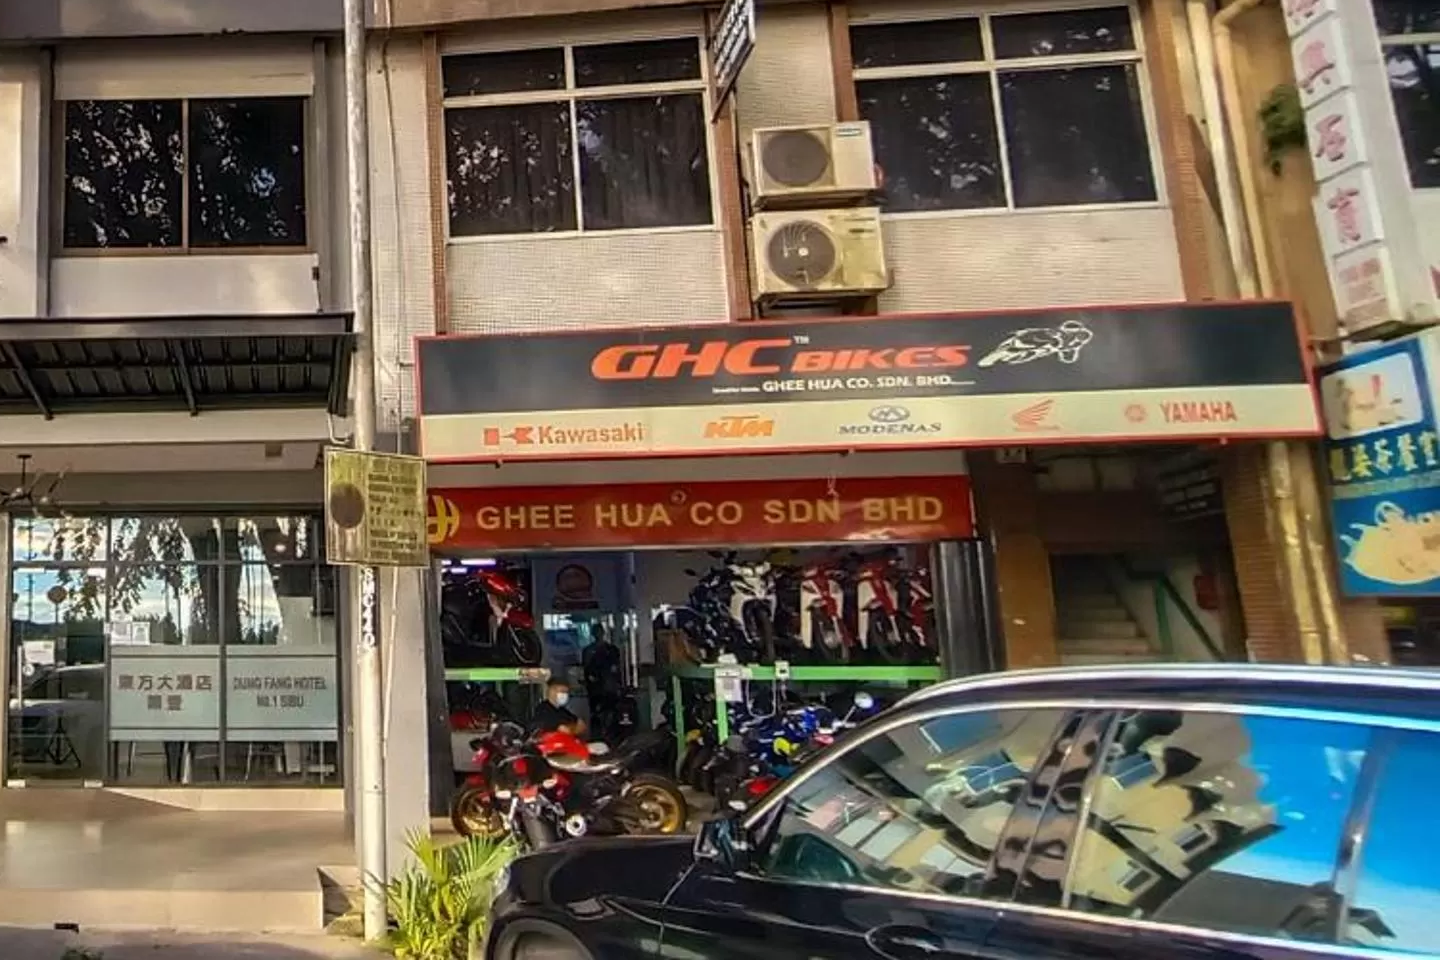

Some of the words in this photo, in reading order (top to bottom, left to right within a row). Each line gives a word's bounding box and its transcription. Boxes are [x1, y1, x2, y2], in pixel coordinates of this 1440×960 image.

[591, 338, 792, 380] GHC
[791, 345, 972, 373] BIKES
[762, 378, 806, 392] GHEE
[810, 377, 844, 390] HUA
[1160, 401, 1238, 423] YAMAHA
[538, 423, 644, 445] Kawasaki
[704, 415, 775, 439] KTM
[838, 422, 942, 436] MODENAS
[476, 505, 575, 530] GHEE
[595, 502, 671, 527] HUA
[690, 501, 743, 526] CO
[764, 499, 841, 524] SDN
[864, 497, 943, 522] BHD
[264, 676, 292, 690] FANG
[294, 676, 328, 690] HOTEL
